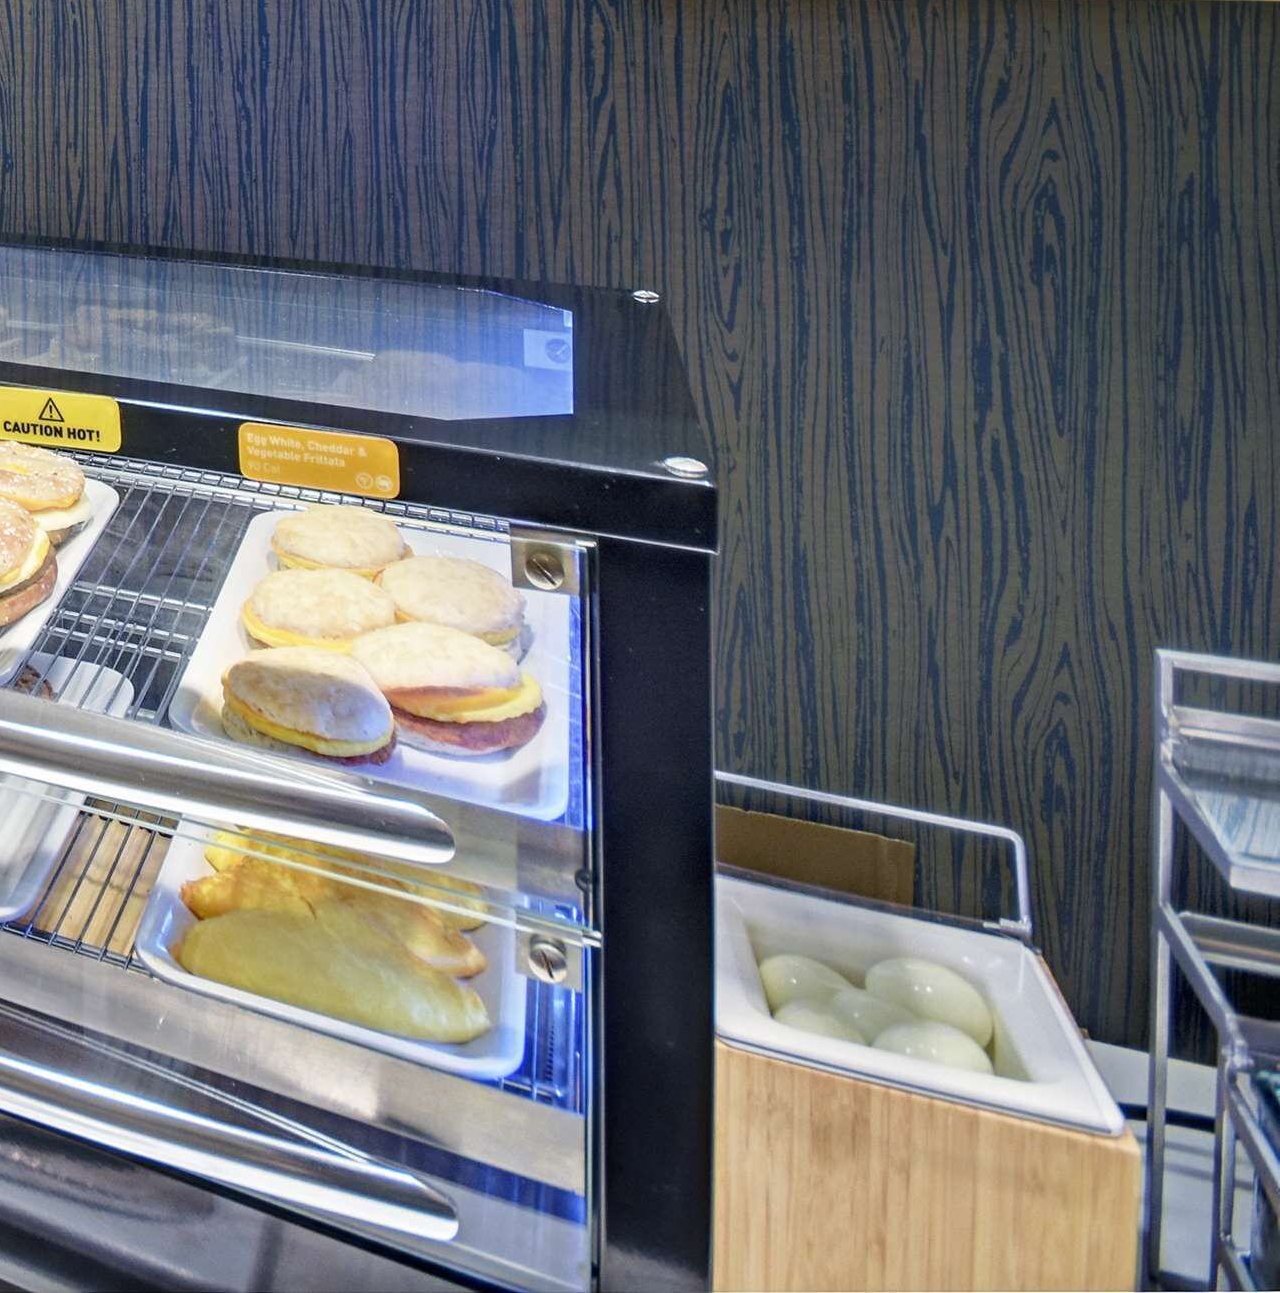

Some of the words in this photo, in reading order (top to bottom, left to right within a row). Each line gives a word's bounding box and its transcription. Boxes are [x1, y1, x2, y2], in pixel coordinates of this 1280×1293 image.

[3, 421, 64, 438] CAUTION
[68, 427, 101, 443] HOT!
[246, 433, 268, 447] Egg
[307, 440, 354, 455] Cheddar
[247, 446, 302, 462] Vegetable
[303, 453, 346, 467] Frittata
